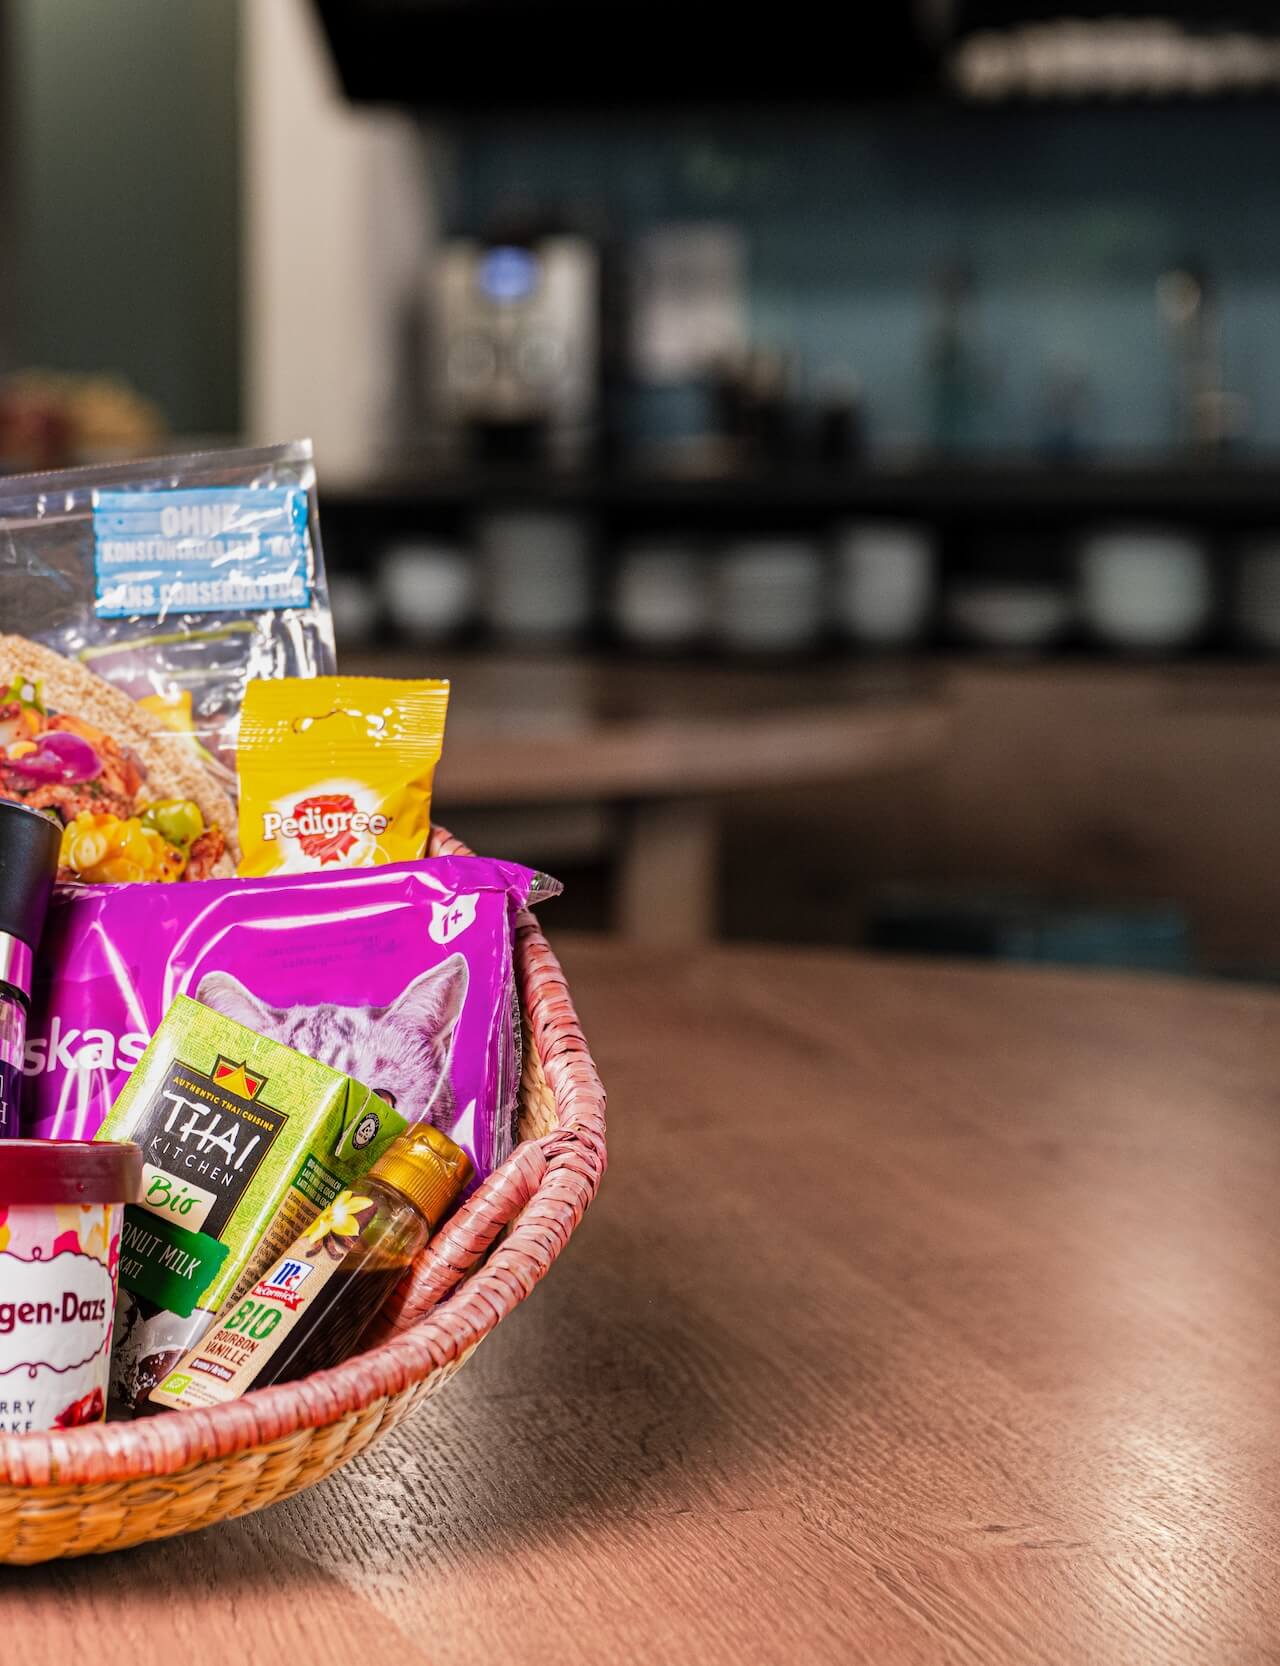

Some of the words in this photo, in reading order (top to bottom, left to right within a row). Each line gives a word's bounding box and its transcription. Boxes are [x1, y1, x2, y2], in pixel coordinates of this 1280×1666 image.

[263, 806, 389, 841] Pedigree
[440, 908, 463, 937] 1+
[23, 1015, 151, 1077] skas
[172, 1076, 220, 1105] AUTHENTIC
[221, 1099, 241, 1115] THAI
[241, 1108, 275, 1132] CUISINE
[162, 1089, 261, 1170] THAI
[150, 1135, 234, 1187] KITCHEN
[144, 1175, 202, 1216] Bio
[122, 1222, 163, 1257] ONUT
[158, 1244, 201, 1280] MILK
[254, 1286, 300, 1304] McCormick
[223, 1300, 282, 1340] BIO
[204, 1340, 250, 1368] VANILLE
[213, 1329, 260, 1353] BOURBON
